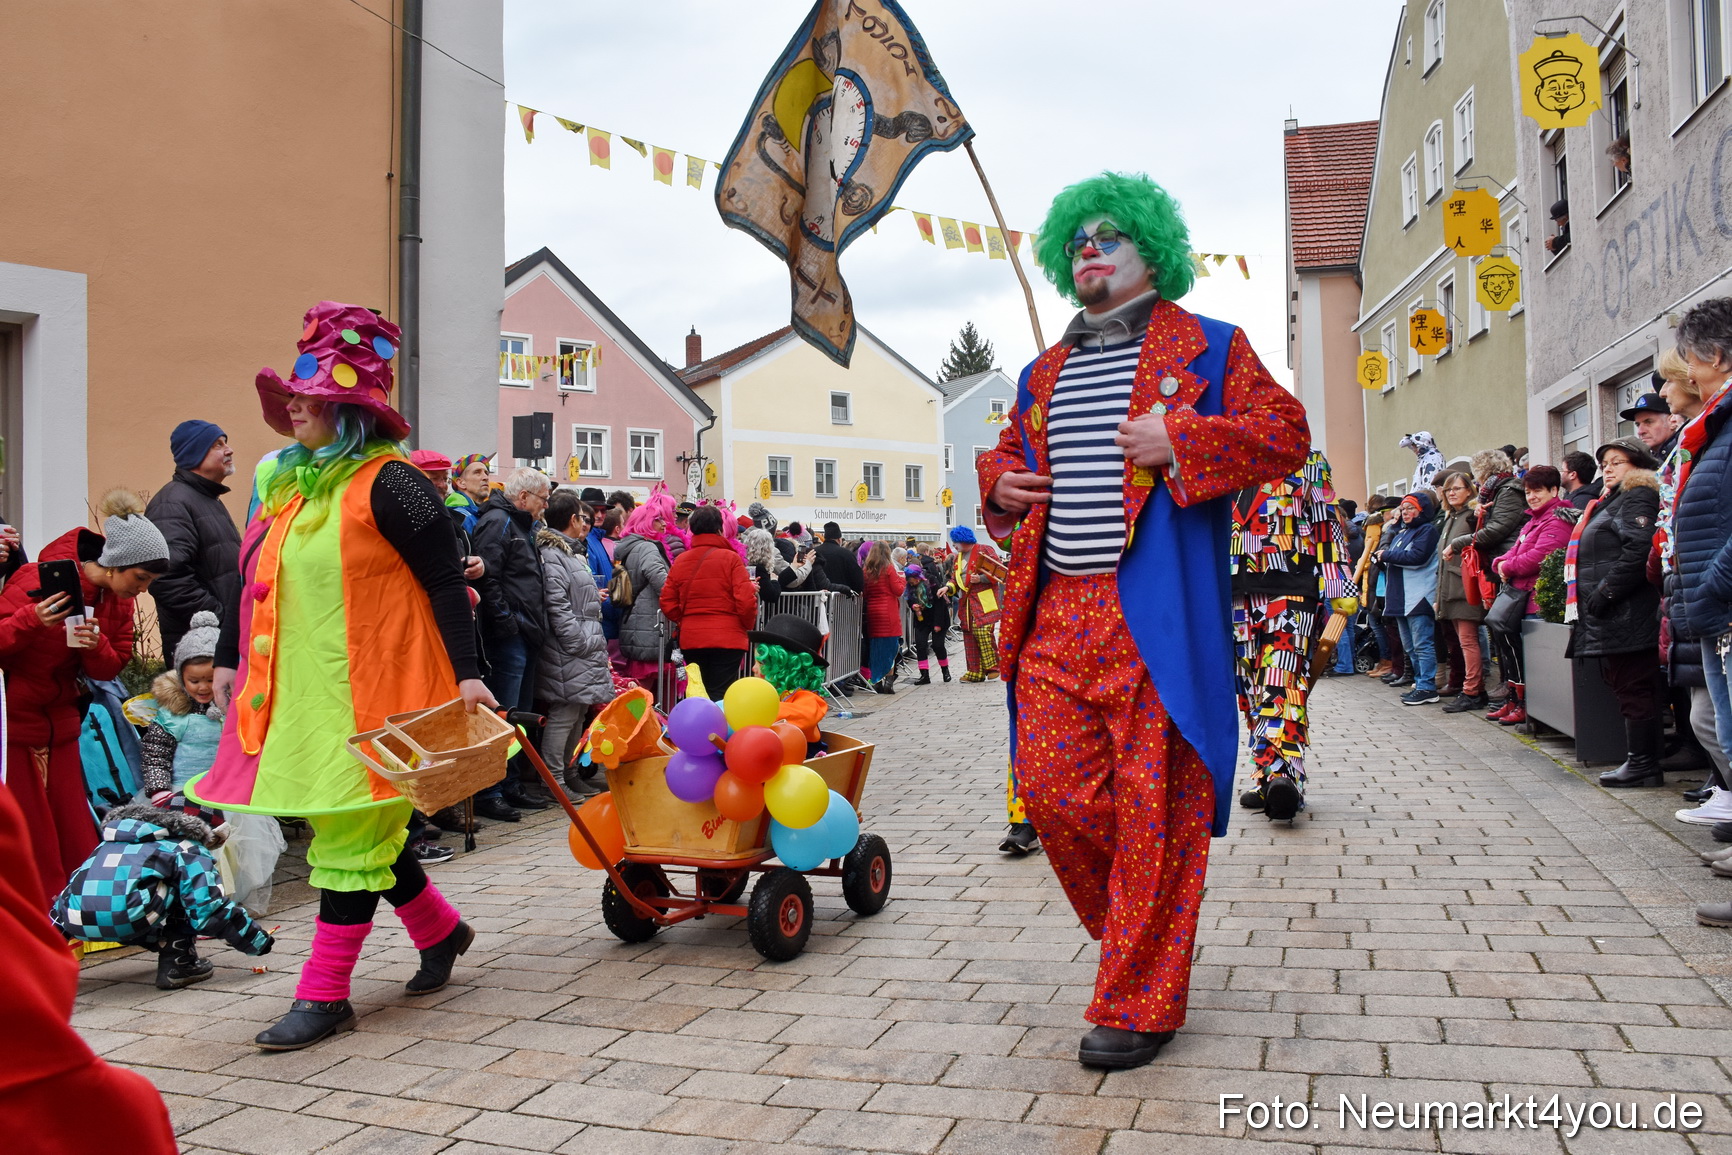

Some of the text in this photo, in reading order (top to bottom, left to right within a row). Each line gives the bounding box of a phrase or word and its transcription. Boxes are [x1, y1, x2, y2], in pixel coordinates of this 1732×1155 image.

[1602, 163, 1703, 319] OPTIK
[813, 508, 888, 523] Schuhmoden Döllinger
